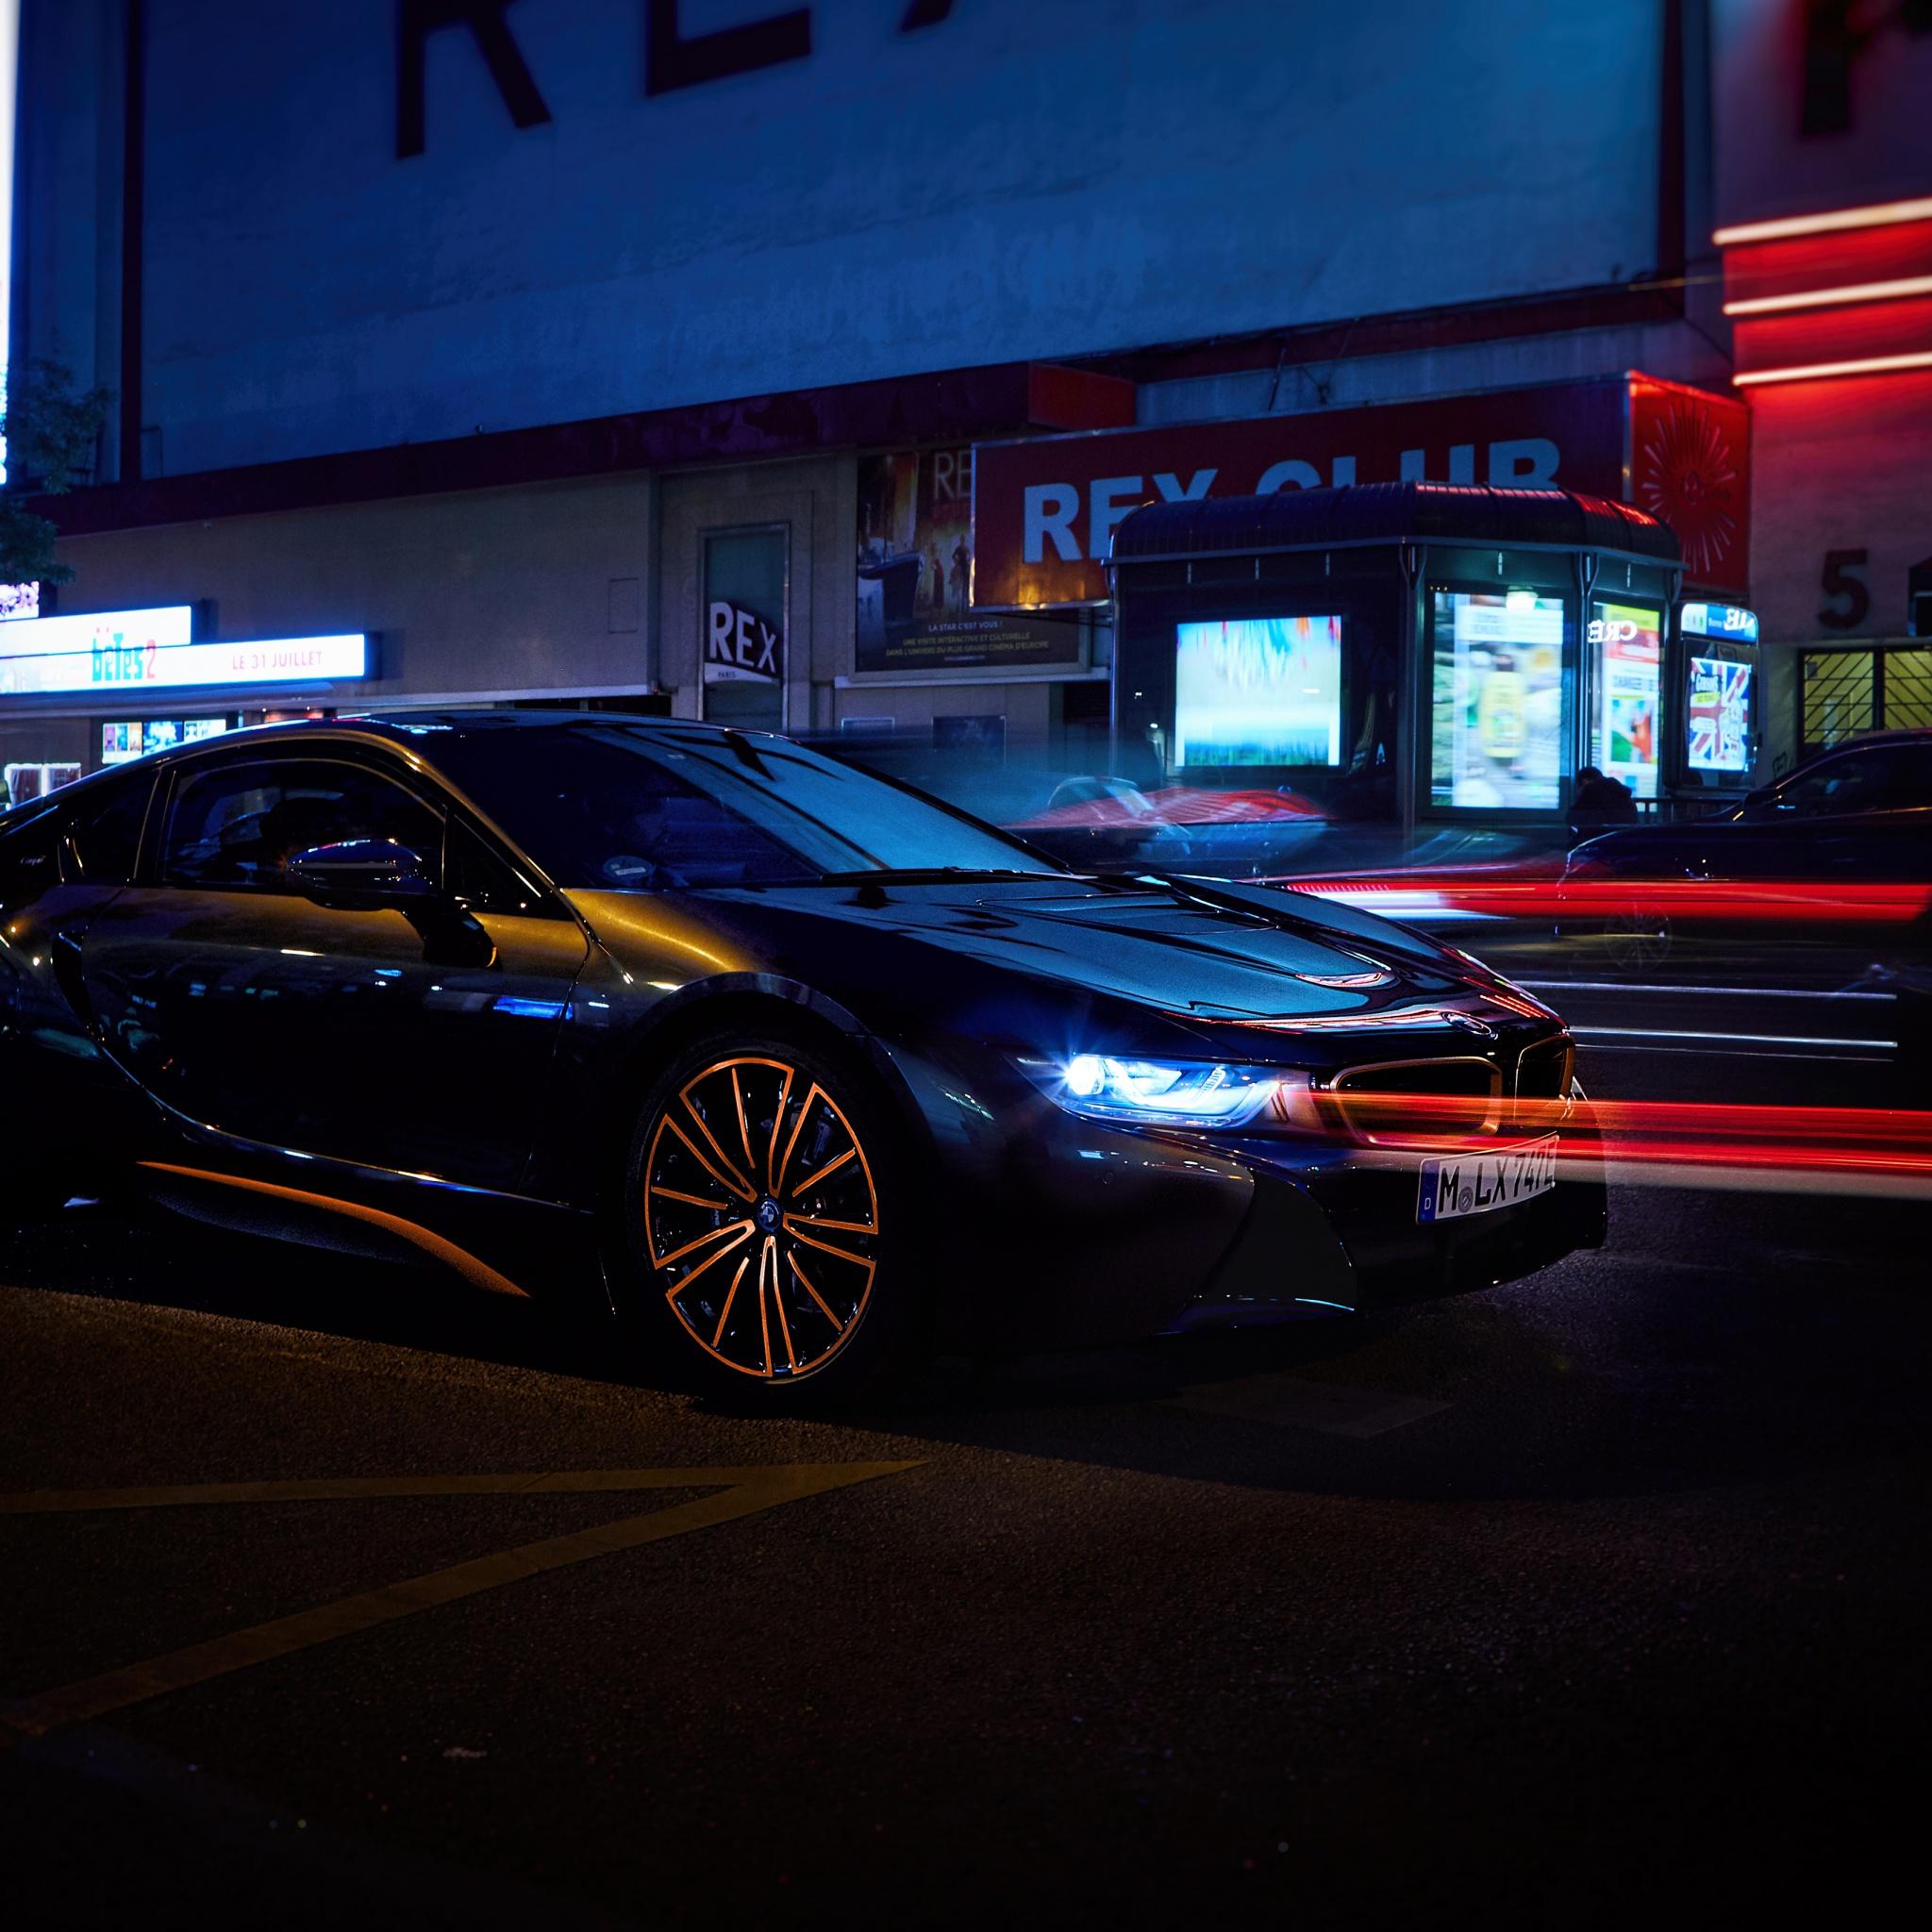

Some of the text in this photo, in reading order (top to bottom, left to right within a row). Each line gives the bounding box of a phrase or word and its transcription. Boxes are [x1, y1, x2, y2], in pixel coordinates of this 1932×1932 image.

[1818, 549, 1870, 629] 5
[940, 623, 957, 631] STAR
[958, 622, 977, 631] C'EST
[979, 621, 998, 629] VOUS
[709, 602, 777, 674] REX
[903, 638, 916, 646] UNE
[917, 637, 936, 645] VISITE
[979, 634, 989, 642] ET
[989, 632, 1031, 641] CULTURELLE
[146, 639, 157, 679] 2
[886, 648, 903, 657] DANS
[937, 645, 946, 654] DU
[947, 645, 963, 654] PLUS
[964, 643, 989, 653] GRAND
[1015, 641, 1050, 650] D'EUROPE
[233, 650, 323, 670] LE 31 JUILLET
[1438, 1165, 1460, 1213] M
[1474, 1157, 1508, 1207] LX
[1424, 1197, 1432, 1210] D
